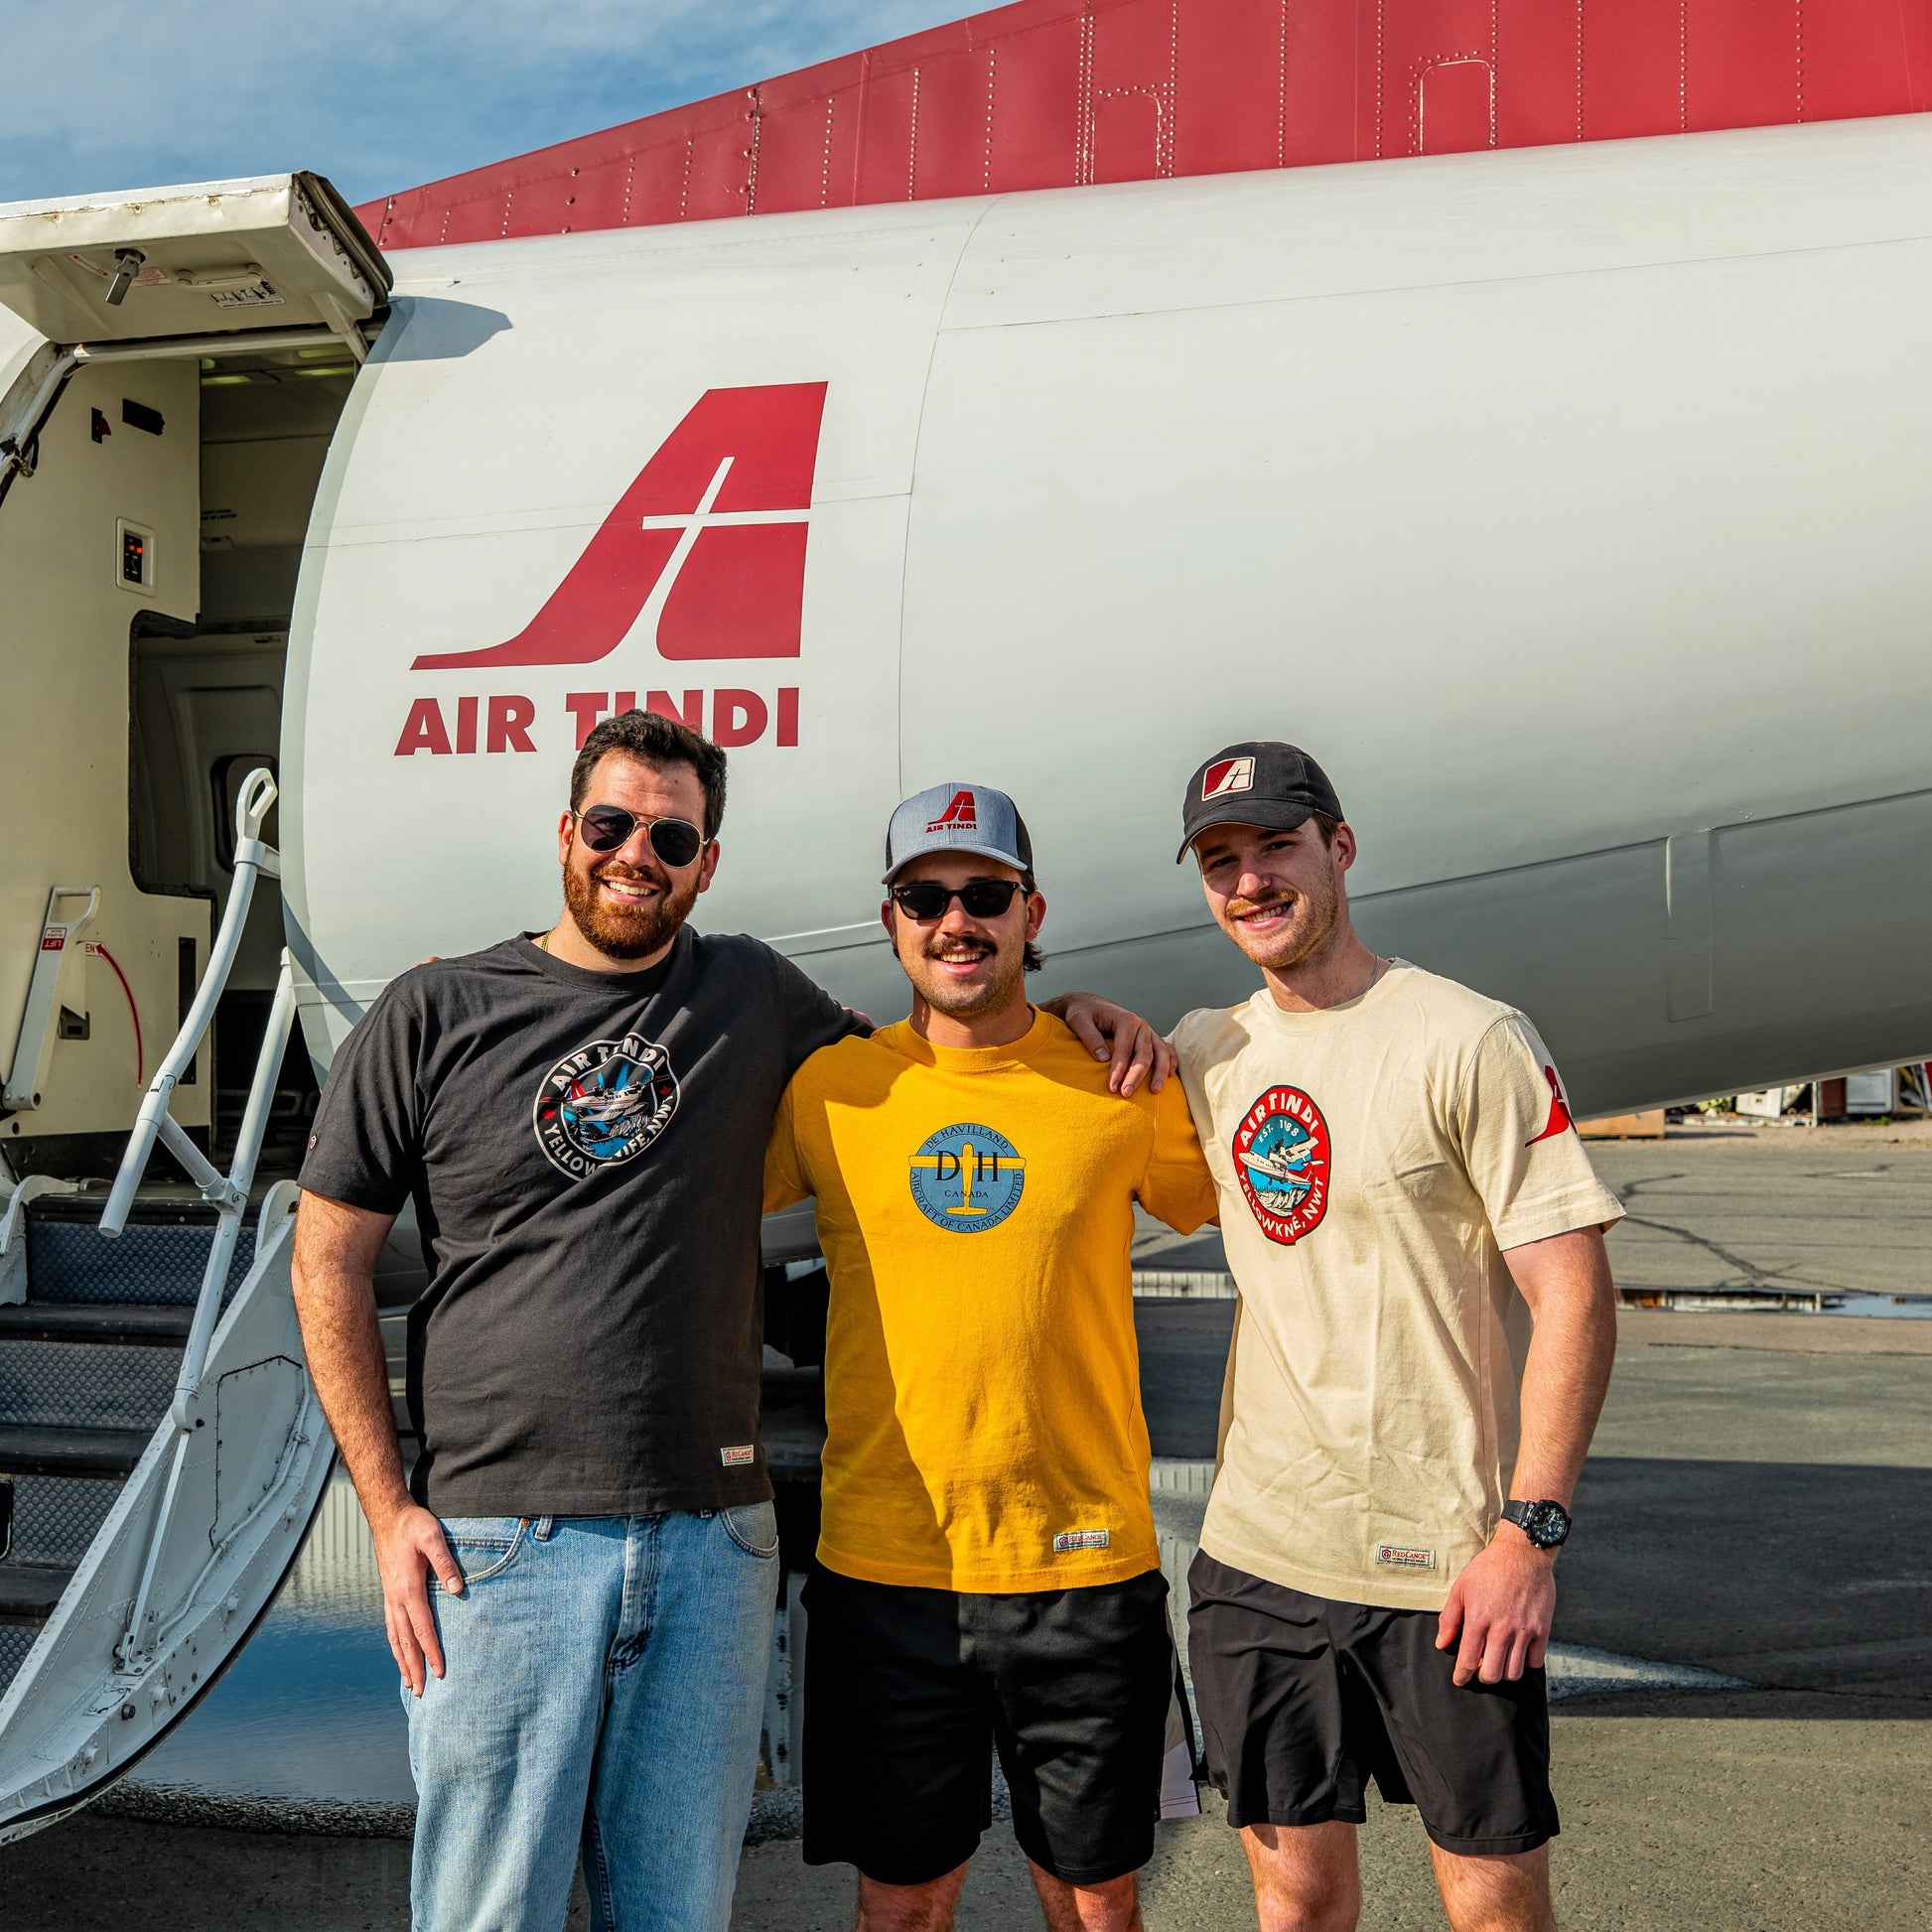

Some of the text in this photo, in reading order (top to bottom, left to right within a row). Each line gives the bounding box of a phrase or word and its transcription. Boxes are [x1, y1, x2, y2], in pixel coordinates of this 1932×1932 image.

[394, 695, 537, 756] AIR
[85, 943, 95, 953] EN
[551, 1052, 592, 1091] AIR
[926, 1125, 1010, 1150] DE HAVILLAND
[1240, 1092, 1319, 1148] AIR TINDI
[1258, 1123, 1274, 1143] EST.
[544, 1123, 650, 1175] YELLOWIFE,
[911, 1172, 1023, 1232] AIRCRAFT OF CANADA LIMITED
[944, 1189, 989, 1198] CANADA
[1302, 1176, 1324, 1221] NWT
